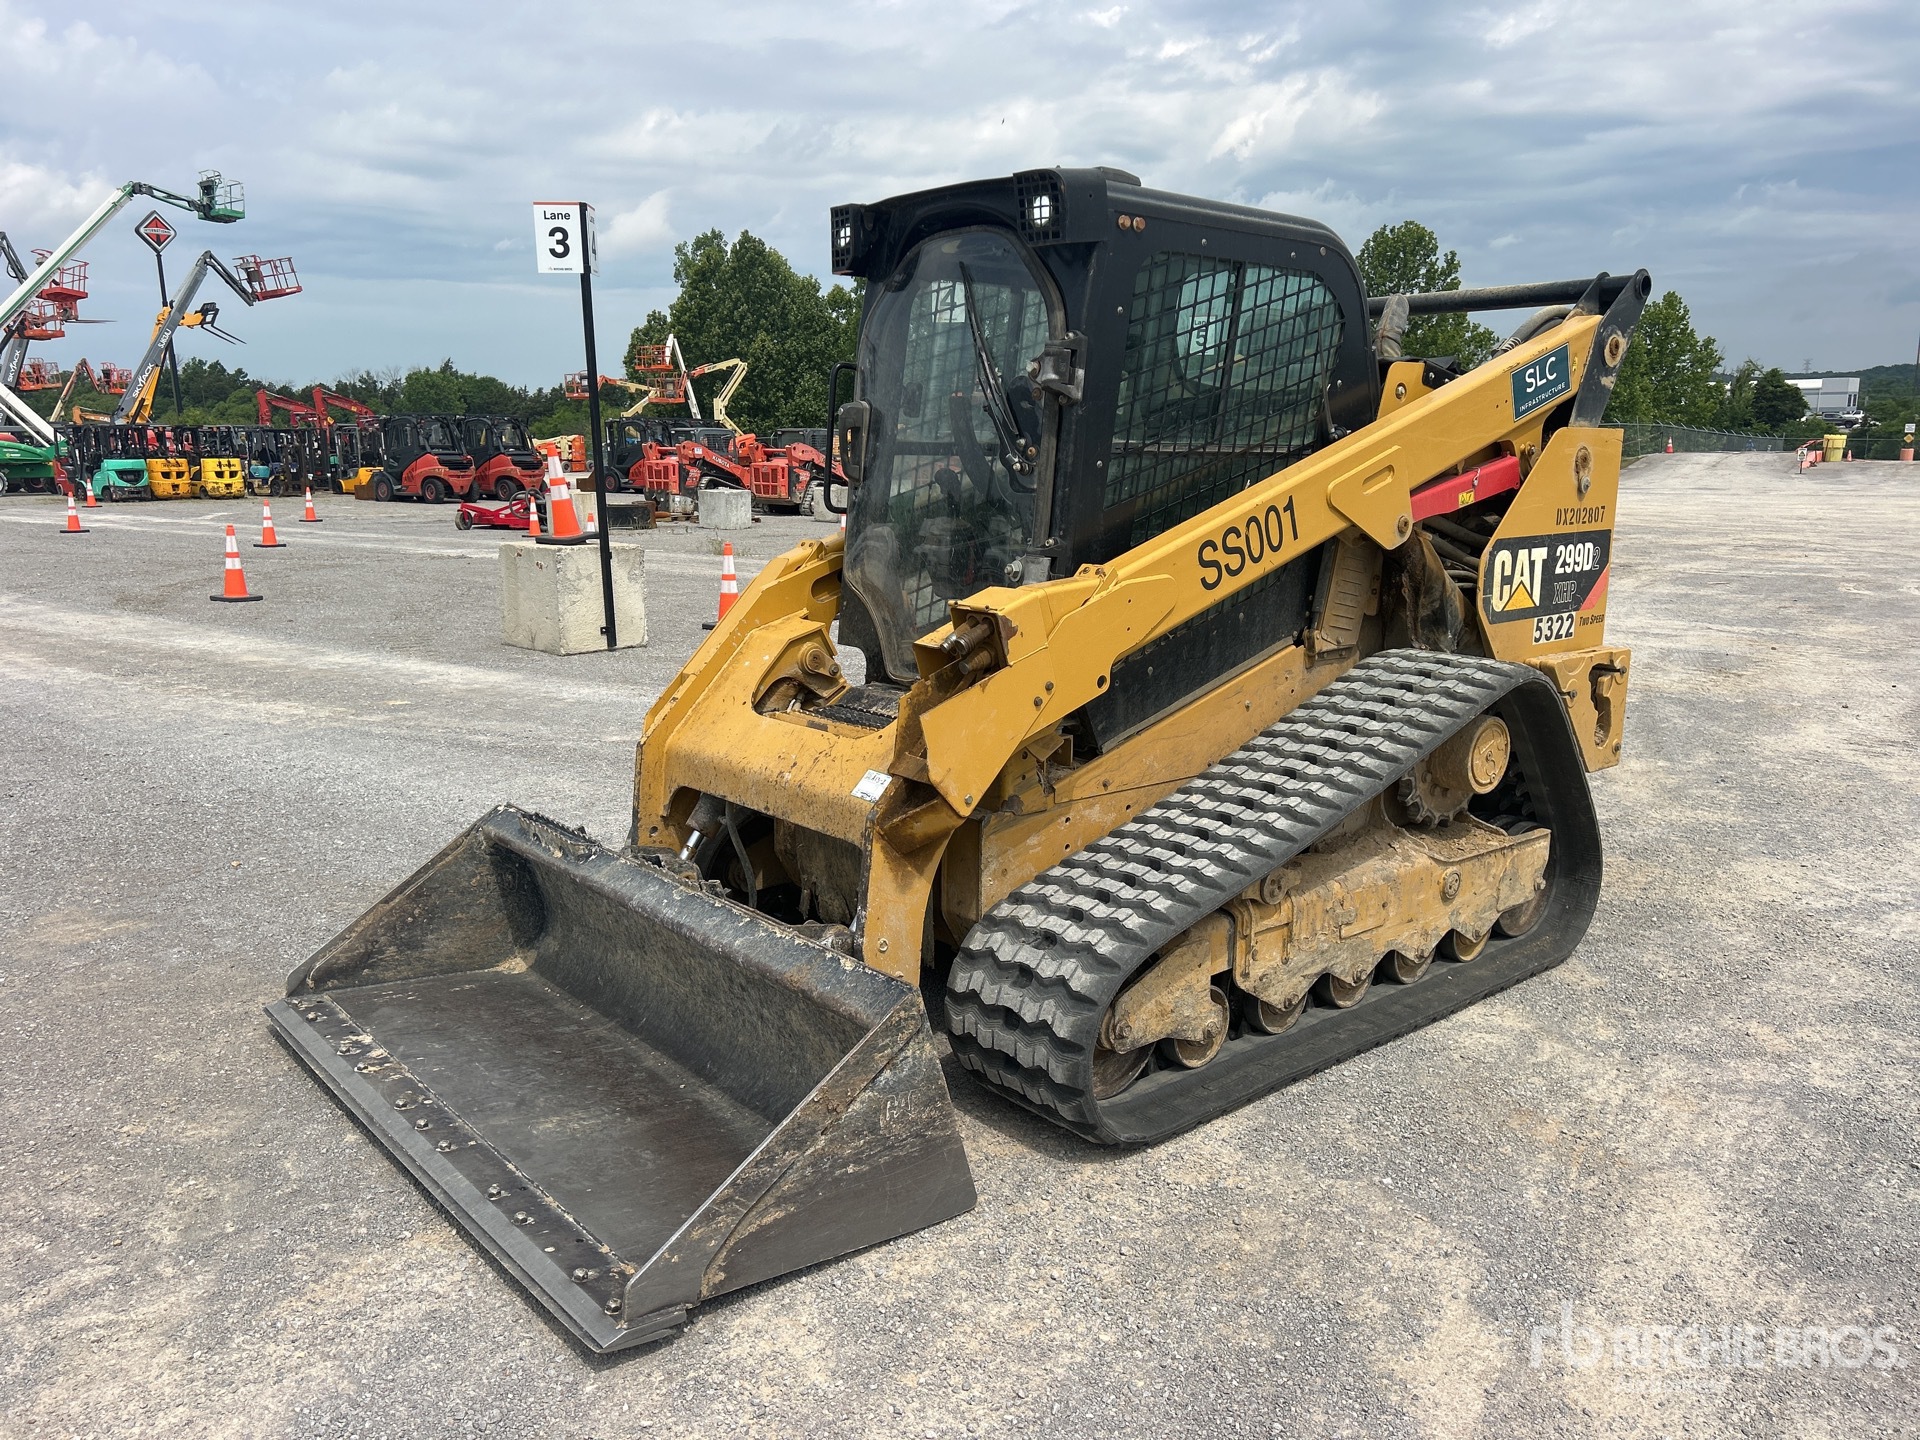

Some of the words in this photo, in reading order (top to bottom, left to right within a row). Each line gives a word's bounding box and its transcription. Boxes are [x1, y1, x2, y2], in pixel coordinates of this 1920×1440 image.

[543, 210, 571, 220] Lane
[548, 226, 571, 259] 3
[7, 349, 21, 383] SKYJACK
[132, 362, 155, 399] SKYJACK
[1525, 356, 1557, 393] SLC
[1519, 381, 1566, 412] INFRASTRUCTURE
[1556, 506, 1606, 526] DX202807
[1198, 495, 1299, 591] SS001
[1492, 547, 1548, 612] CAT
[1552, 580, 1577, 604] XHP
[1534, 613, 1575, 643] 5322
